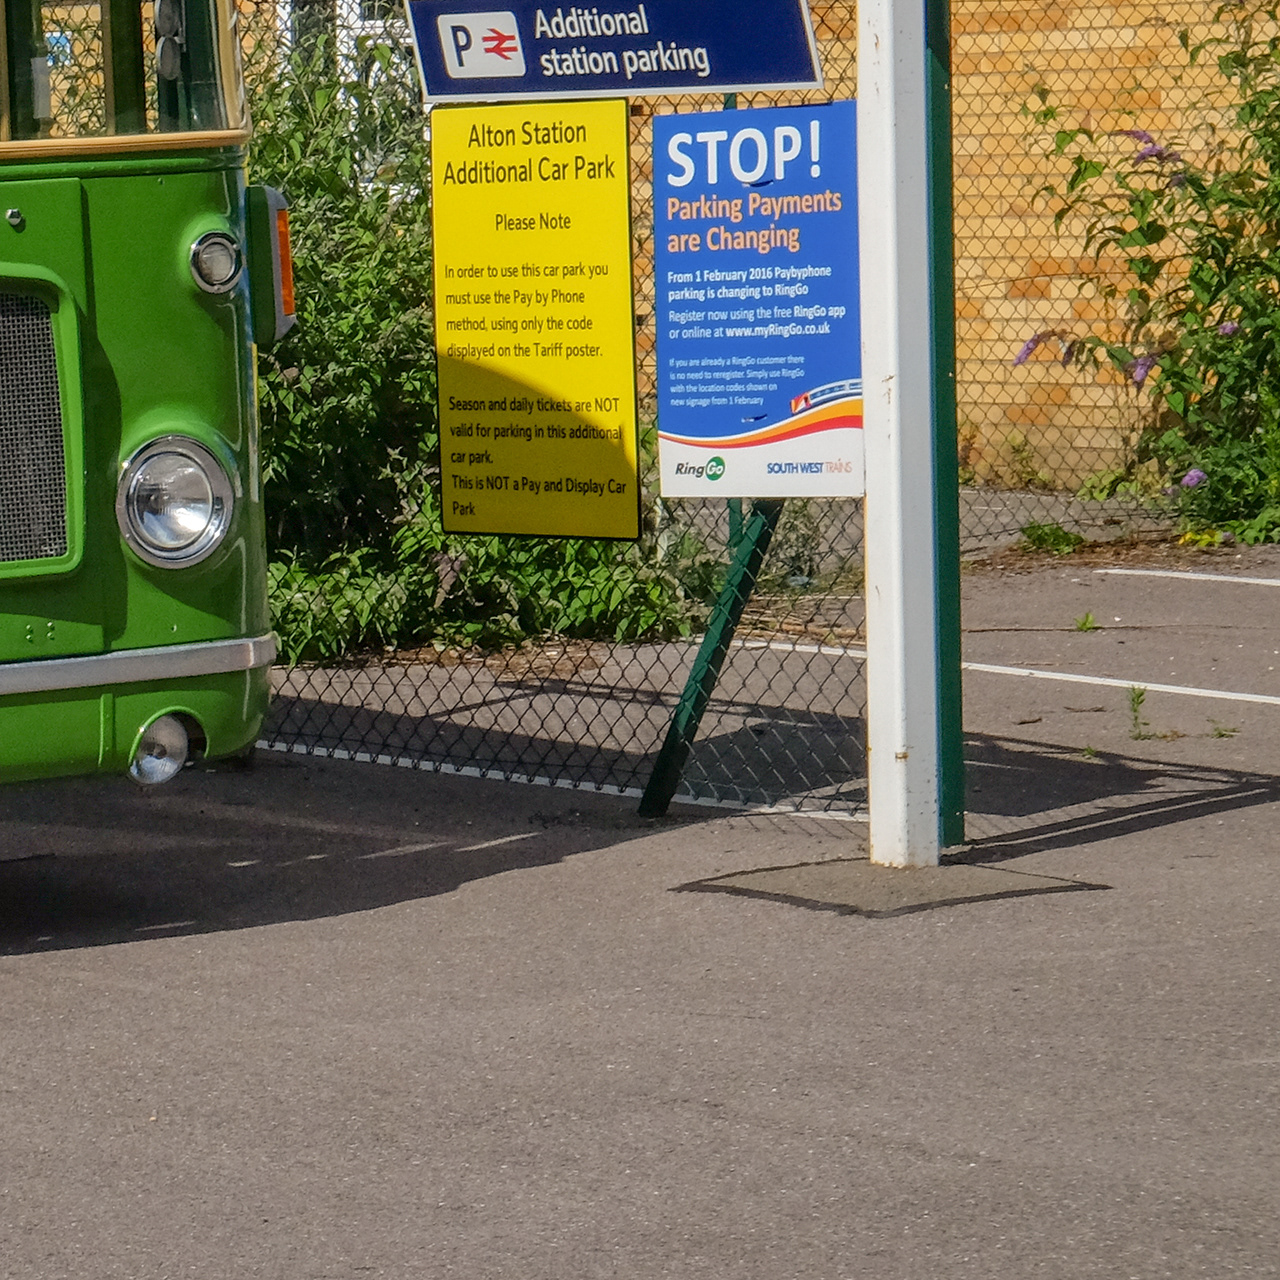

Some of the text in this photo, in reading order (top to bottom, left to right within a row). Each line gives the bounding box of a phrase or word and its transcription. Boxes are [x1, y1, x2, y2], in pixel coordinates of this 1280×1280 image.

[535, 4, 649, 39] Additional
[541, 42, 709, 79] station parking
[468, 121, 586, 148] Alton Station
[668, 120, 821, 187] STOP!
[443, 154, 615, 185] Additional Car Park
[668, 190, 842, 222] Parking Payments
[496, 213, 571, 231] Please Note
[668, 224, 800, 253] are Changing
[445, 262, 608, 279] In order to use this car park you
[668, 271, 692, 283] From
[696, 271, 701, 282] 1
[704, 270, 747, 283] February
[749, 268, 772, 279] 2016
[446, 289, 585, 307] must use the Pay by Phone
[668, 283, 808, 302] parking is changing to RingGo
[669, 305, 845, 324] Register now using the free RingGo app
[491, 318, 518, 333] using
[521, 316, 543, 333] only
[547, 317, 563, 330] the
[567, 316, 592, 329] code
[669, 322, 830, 339] or online at www.myRingGo.co.uk
[447, 343, 602, 360] displayed on the Tariff poster.
[449, 396, 619, 414] Season and daily tickets are NOT
[450, 424, 622, 441] valid for parking in this additional
[451, 451, 493, 465] car park.
[767, 459, 853, 474] SOUTH WEST TRAINS
[675, 460, 724, 479] RingGo
[452, 475, 626, 496] This is NOT a Pay and Display Car
[453, 501, 475, 515] Park
